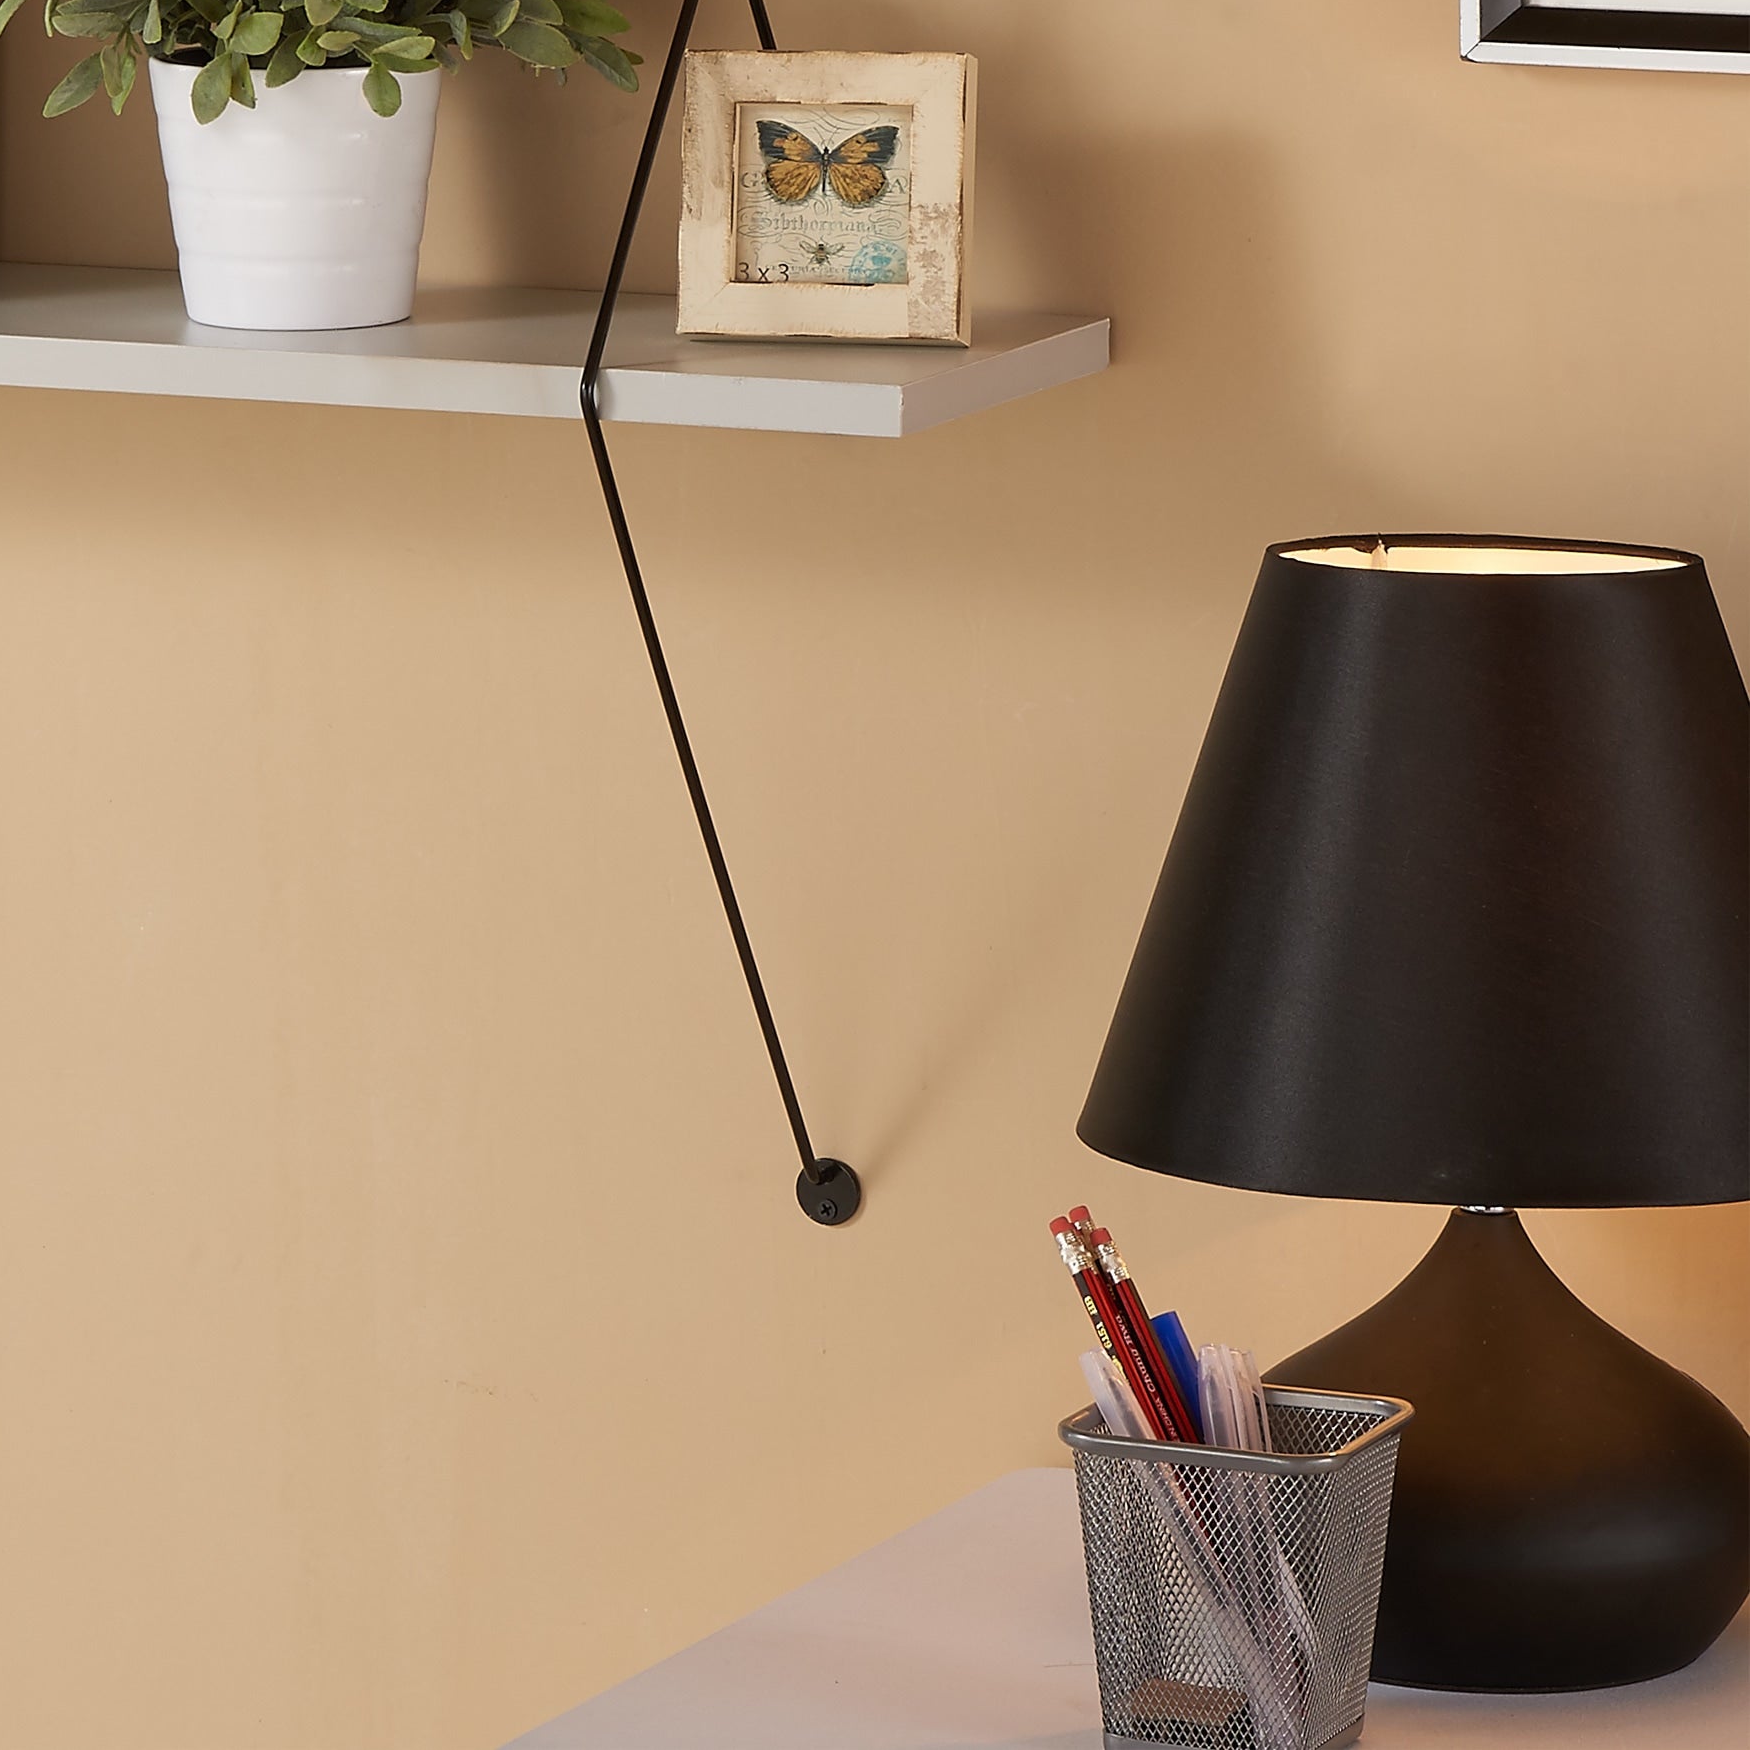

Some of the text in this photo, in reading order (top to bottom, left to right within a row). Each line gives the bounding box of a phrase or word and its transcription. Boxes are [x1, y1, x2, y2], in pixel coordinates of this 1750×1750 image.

[738, 262, 750, 282] 3
[778, 263, 790, 282] 3
[1084, 1295, 1113, 1349] 6151 HB
[1130, 1349, 1155, 1393] Chung
[1155, 1397, 1171, 1426] CHINA
